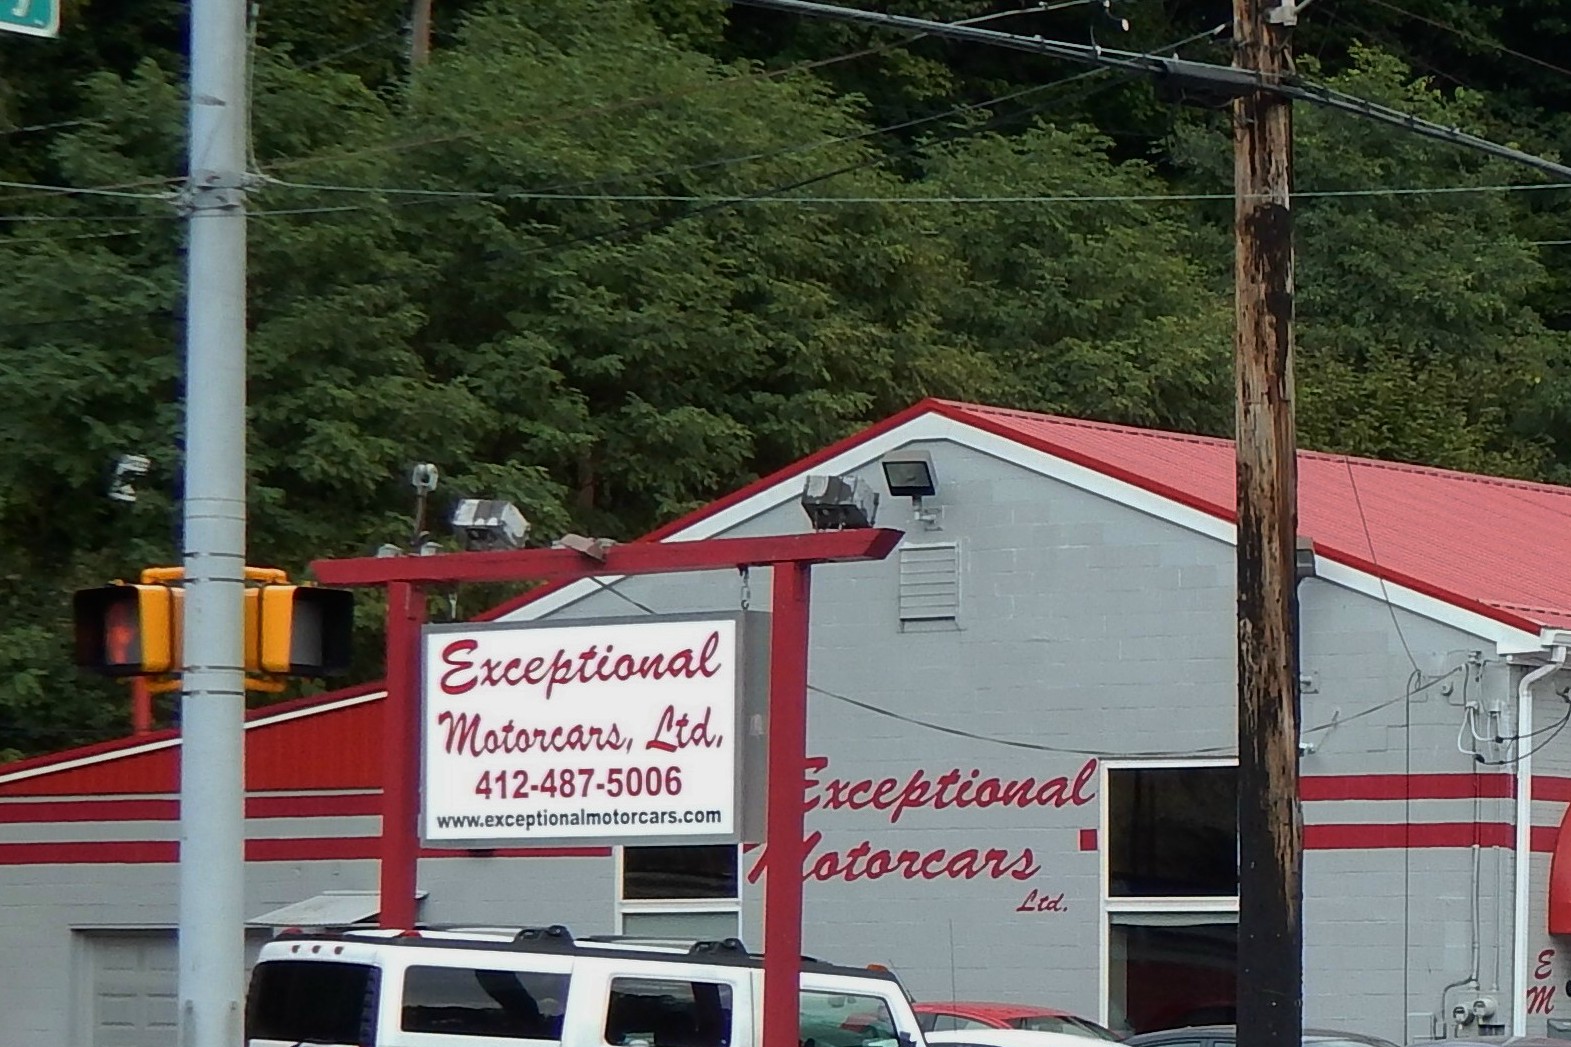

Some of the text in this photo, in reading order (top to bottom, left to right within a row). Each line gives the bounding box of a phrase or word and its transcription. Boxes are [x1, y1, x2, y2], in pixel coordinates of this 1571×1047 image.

[440, 631, 721, 700] Exceptional
[438, 711, 634, 757] Motorcars,
[475, 766, 682, 800] 412-487-5006
[437, 808, 721, 831] www.exceptionalmotorcars.com
[1016, 889, 1068, 912] Ltd.
